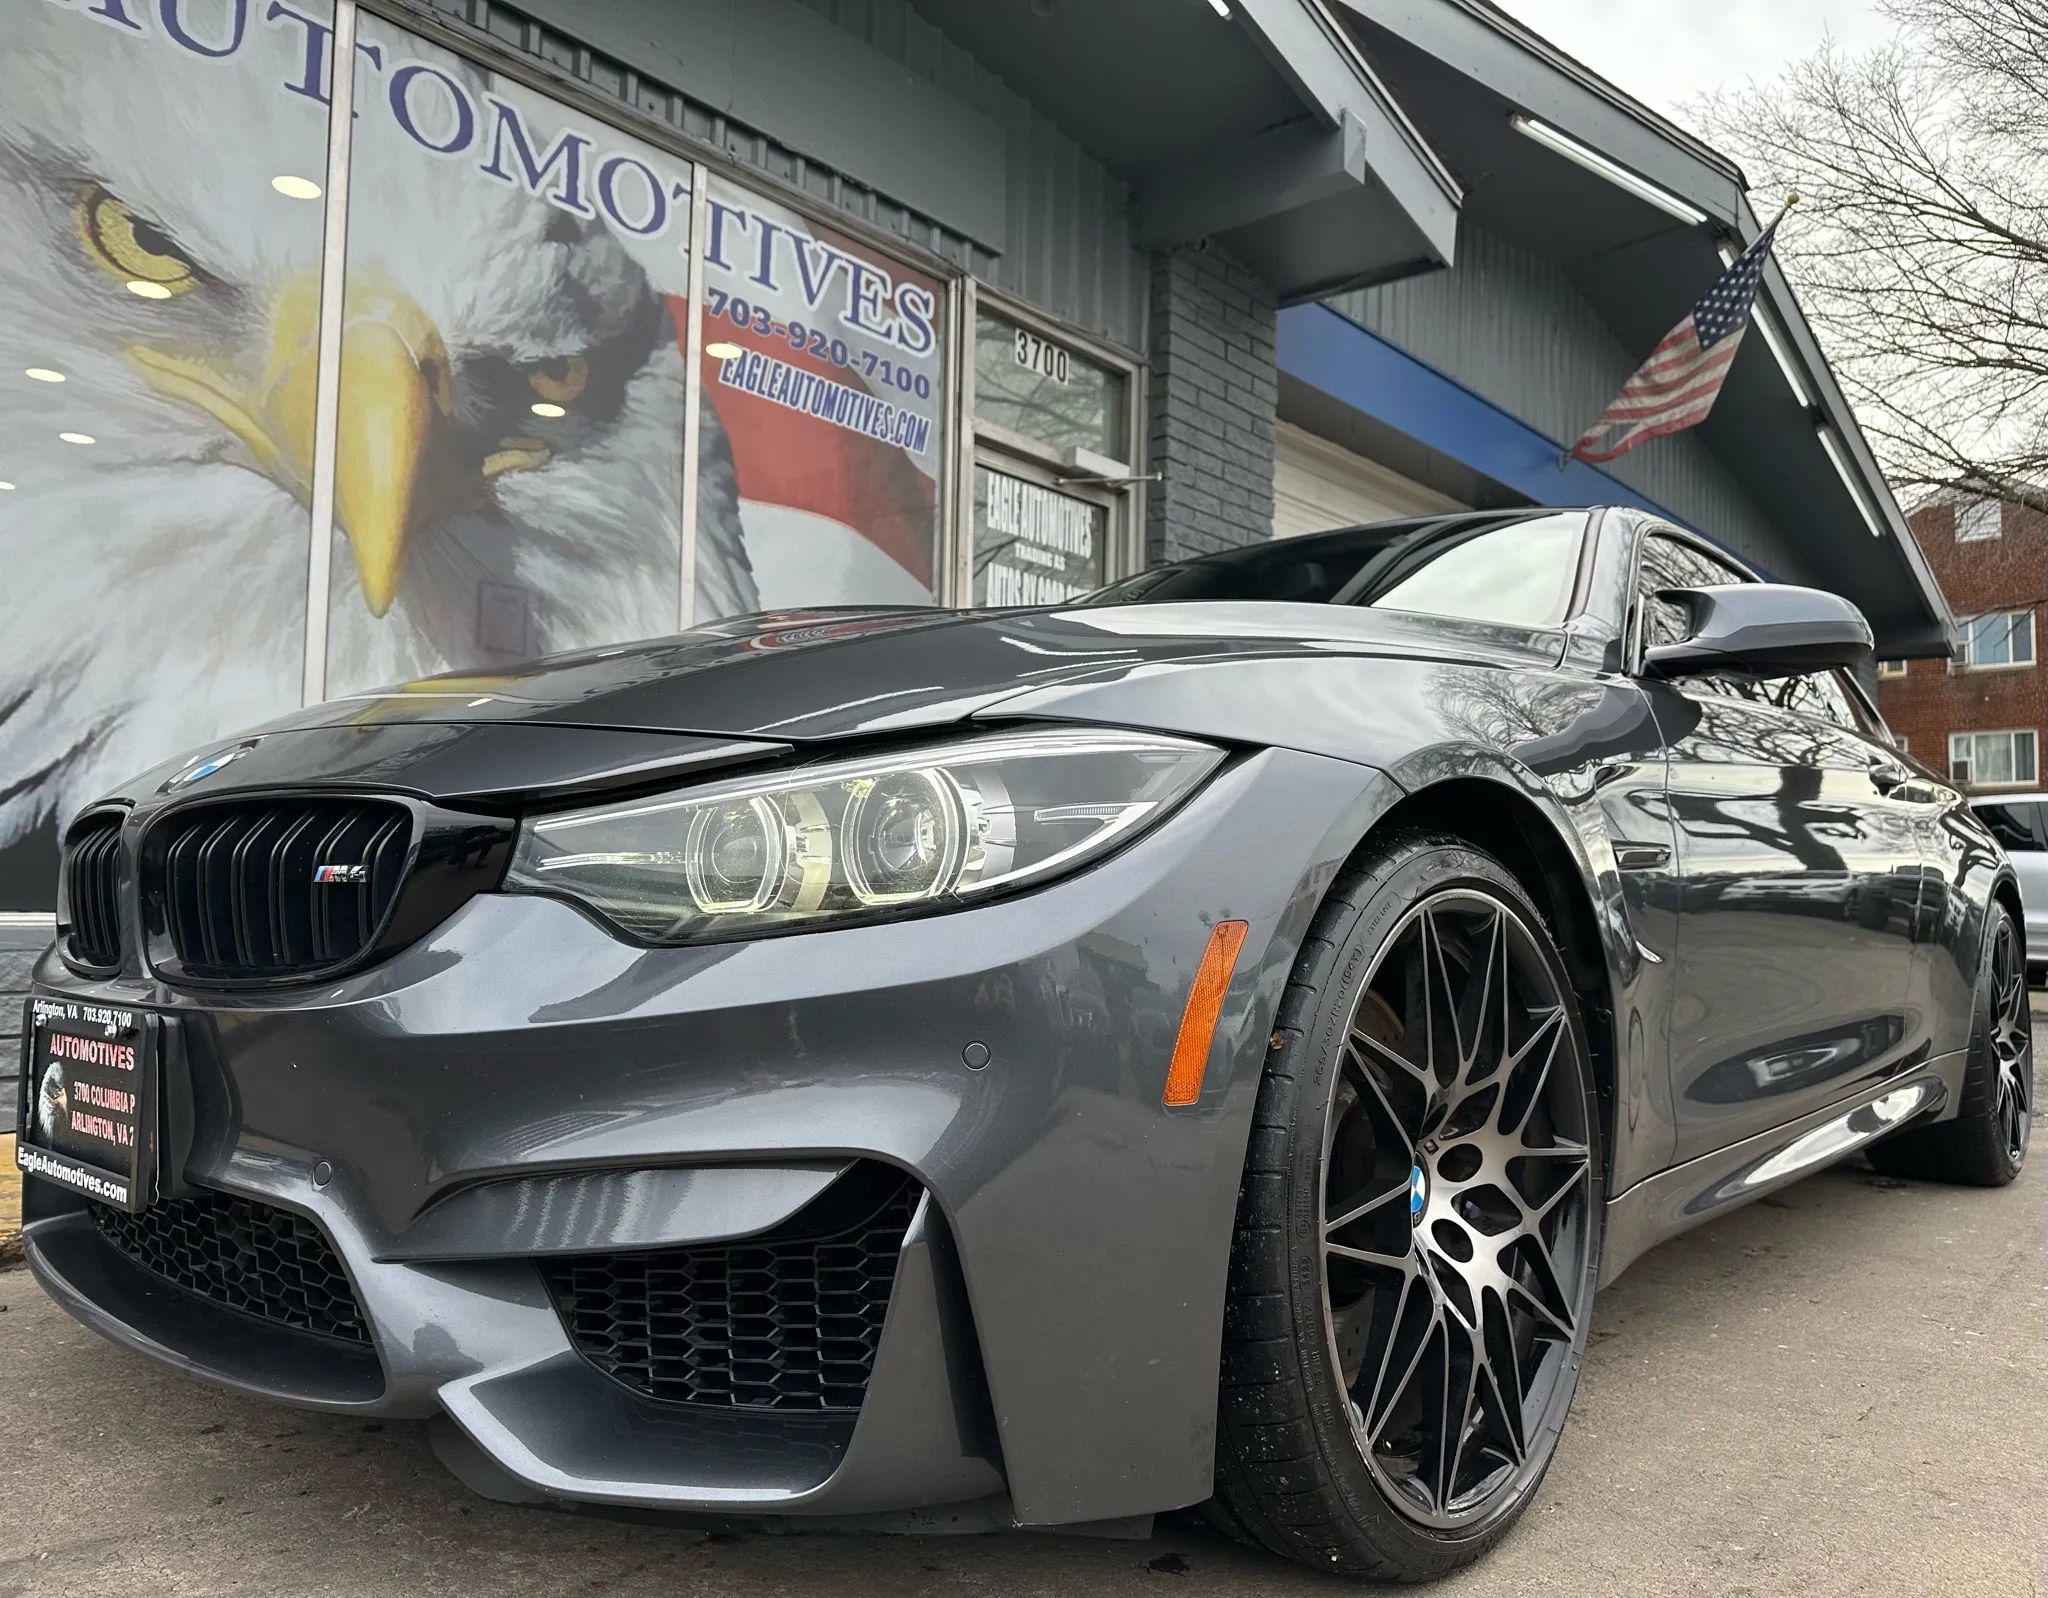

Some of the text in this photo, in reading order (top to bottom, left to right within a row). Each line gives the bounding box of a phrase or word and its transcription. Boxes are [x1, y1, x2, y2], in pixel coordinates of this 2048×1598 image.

[58, 0, 939, 353] UTOMOTIVES
[707, 286, 931, 400] 703-920-7100
[1017, 331, 1067, 382] 3700
[720, 347, 931, 454] EAGLEAUTOMOTIVES.COM
[986, 471, 1092, 559] EAGLE AUTOMOTIVES
[1014, 541, 1066, 571] TRADING AS
[33, 1000, 132, 1028] Arlington, VA 703.920.7100
[50, 1033, 135, 1071] AUTOMOTIVES
[74, 1081, 90, 1104] 3700
[90, 1085, 129, 1114] COLUMBIA
[71, 1110, 116, 1146] ARLINGTON,
[116, 1122, 129, 1146] VA
[18, 1147, 128, 1204] EagleAutomotives.com
